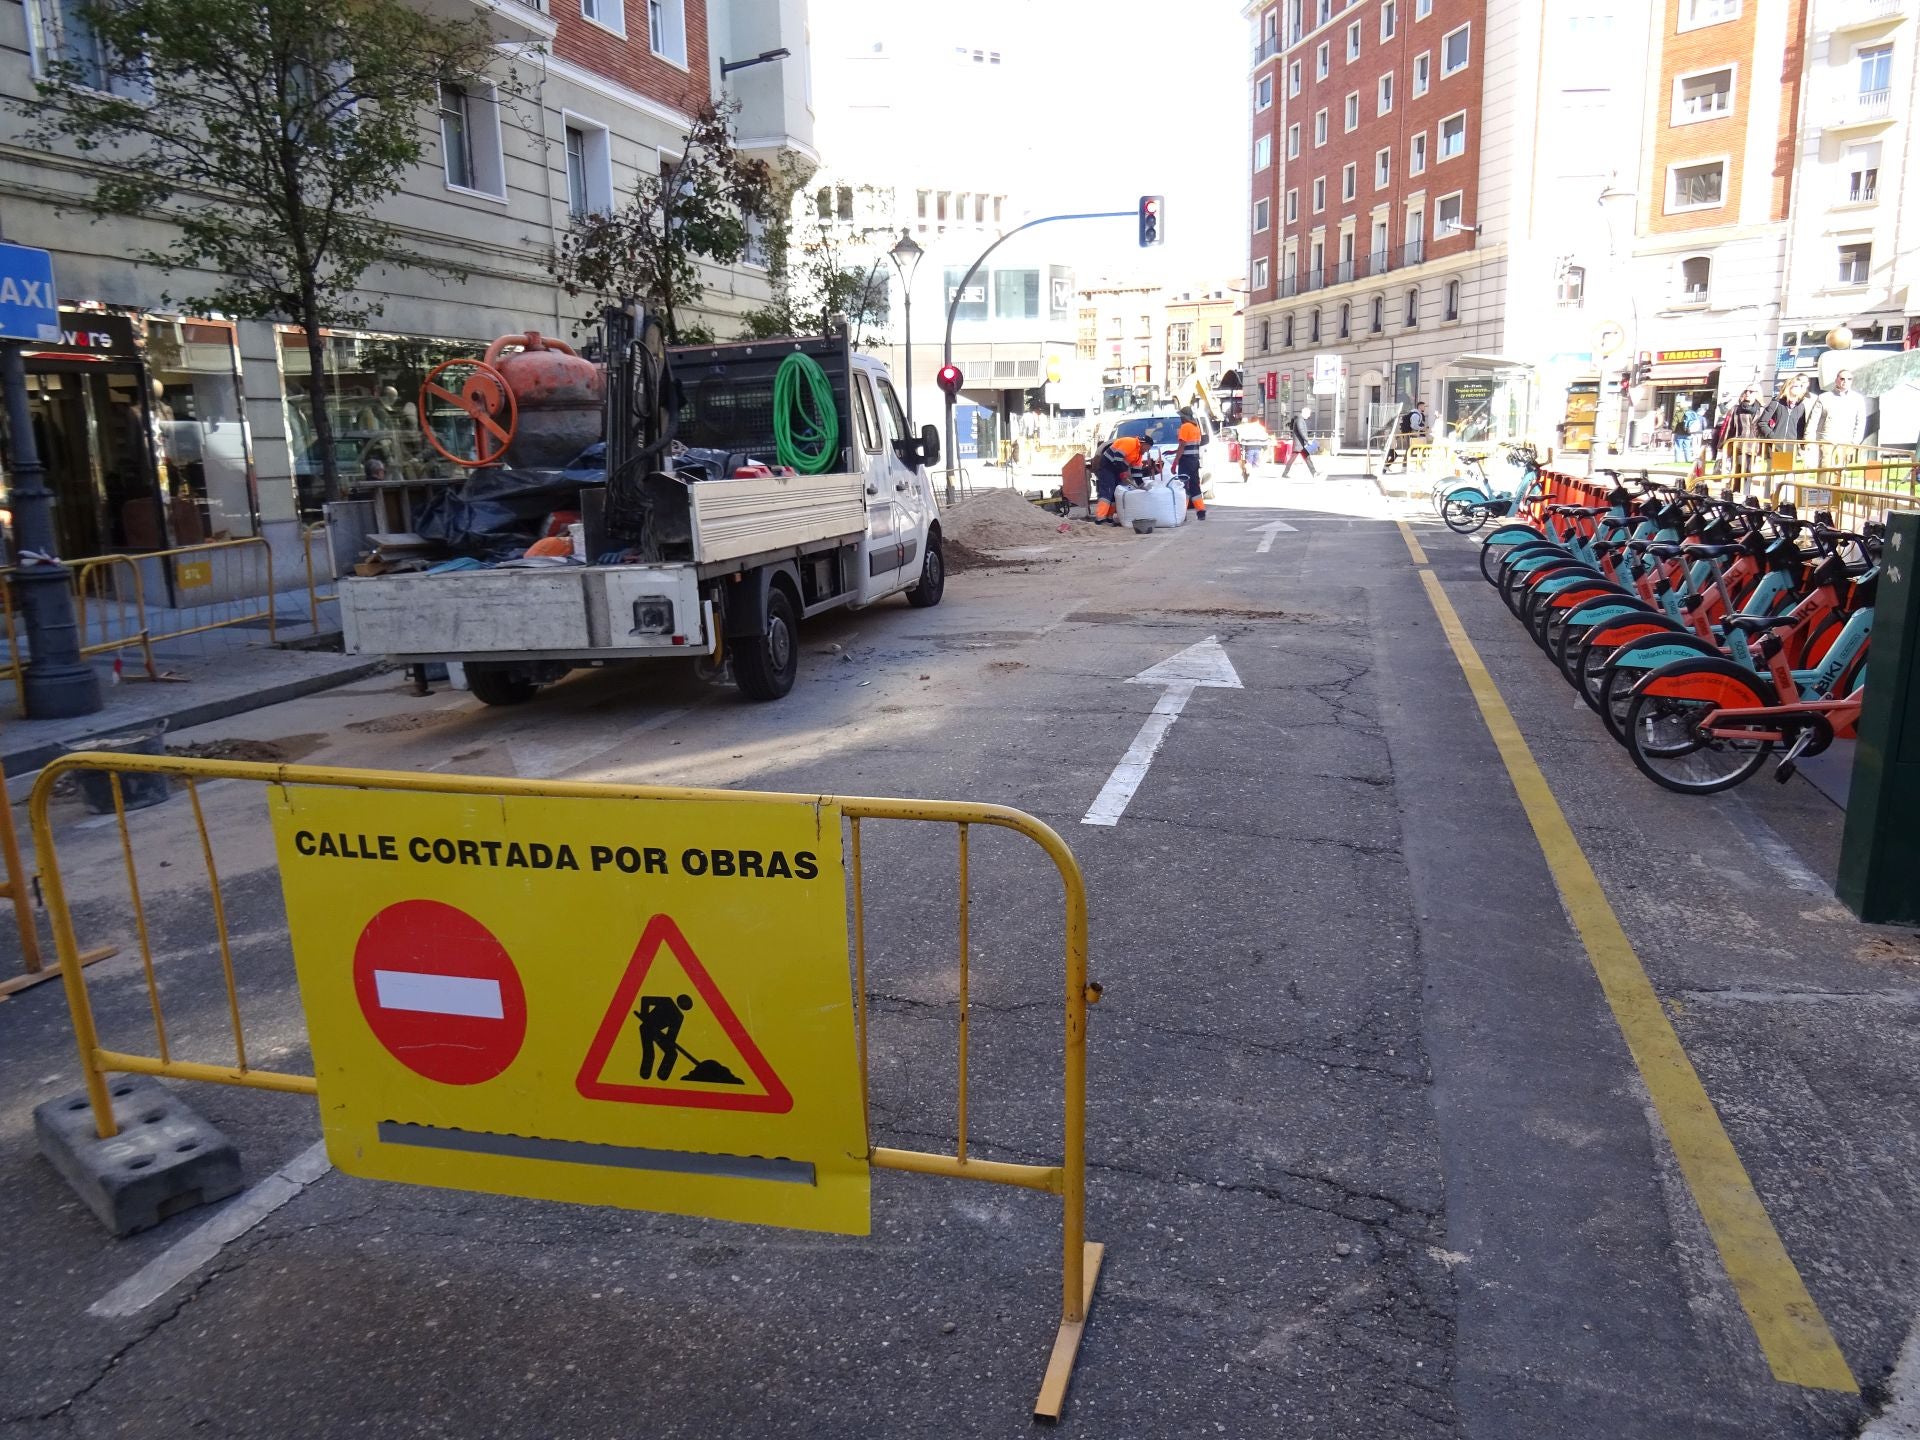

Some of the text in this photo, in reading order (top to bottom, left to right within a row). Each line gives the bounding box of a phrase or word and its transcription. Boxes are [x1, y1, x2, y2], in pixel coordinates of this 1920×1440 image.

[1663, 350, 1714, 360] TABACOS
[1818, 660, 1844, 692] BIKI
[295, 830, 820, 880] CALLE CORTADA POR OBRAS
